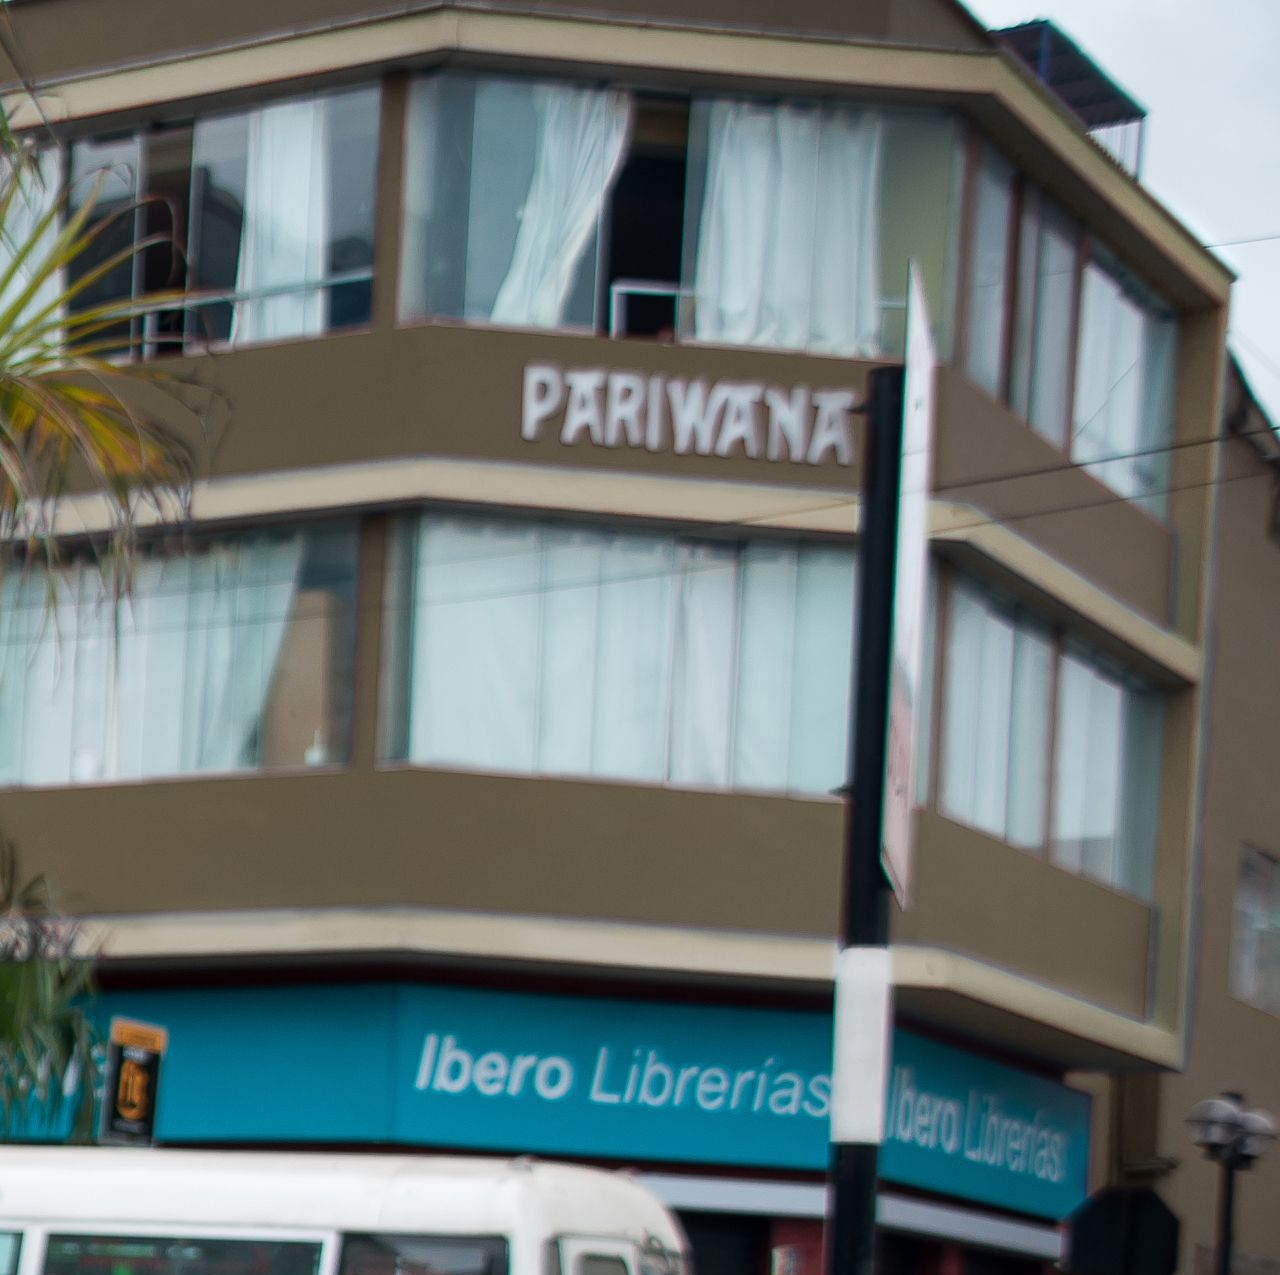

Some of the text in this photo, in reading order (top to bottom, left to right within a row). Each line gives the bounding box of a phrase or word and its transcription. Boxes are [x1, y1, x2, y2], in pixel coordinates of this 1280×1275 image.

[521, 364, 854, 465] PARIWANA
[413, 1032, 832, 1119] Ibero Librerías
[889, 1066, 1070, 1185] Ibero Librerías
